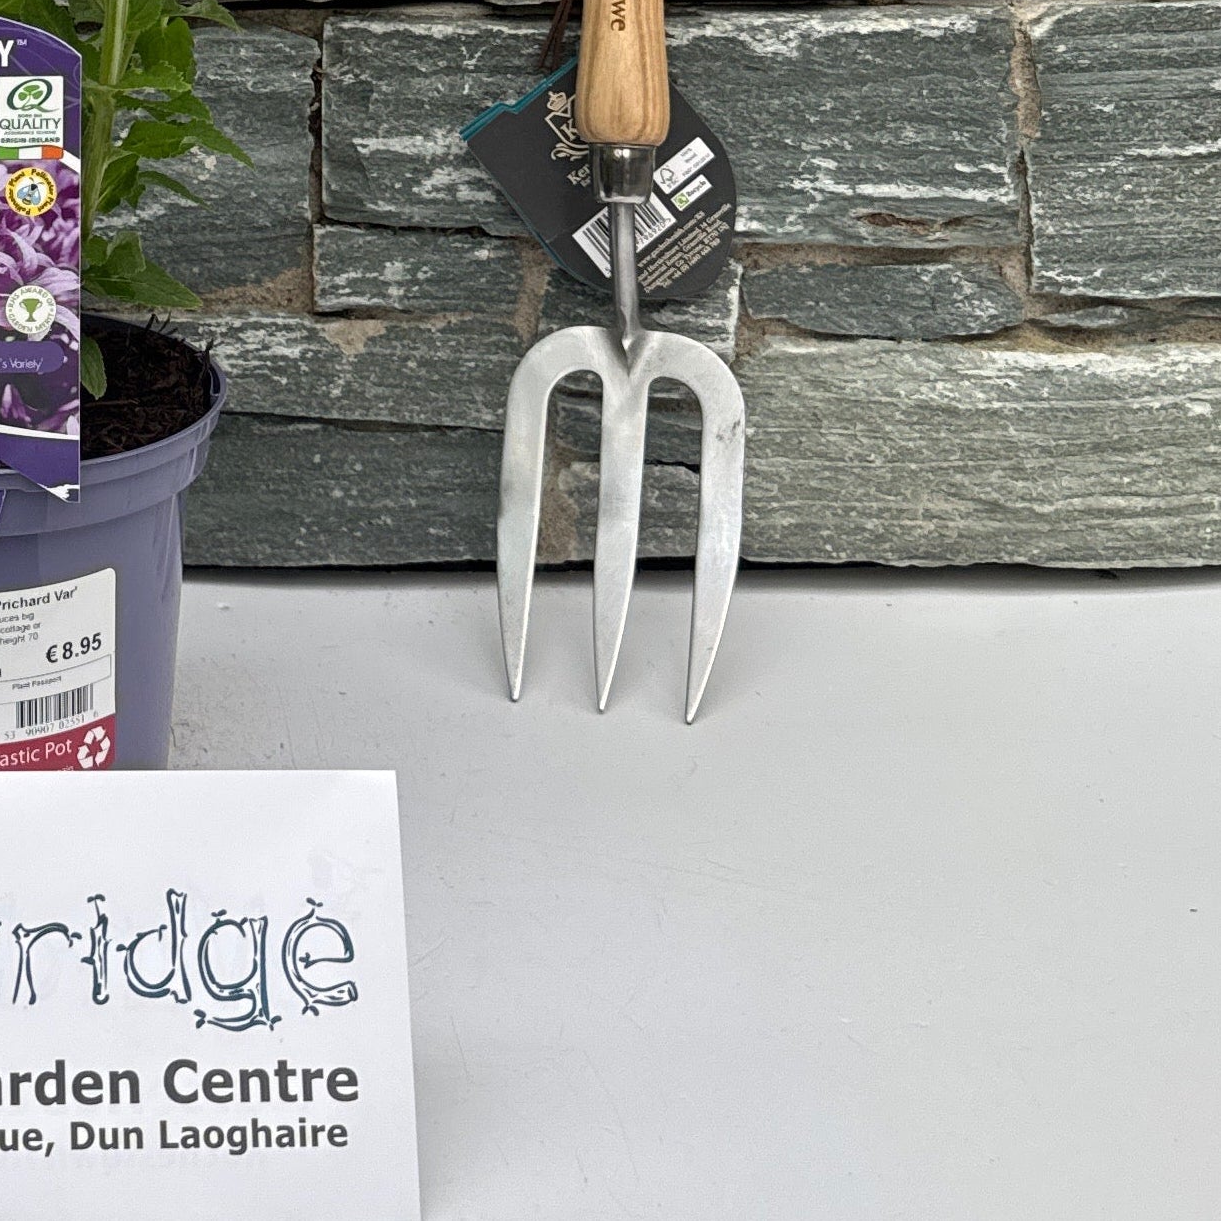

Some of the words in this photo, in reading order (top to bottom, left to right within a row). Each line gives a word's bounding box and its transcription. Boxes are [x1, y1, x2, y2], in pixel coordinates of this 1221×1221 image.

[0, 118, 61, 130] QUALITY
[21, 612, 35, 621] big
[0, 623, 31, 634] cottage
[0, 635, 26, 646] height
[28, 632, 39, 640] 70
[45, 644, 58, 664] €
[61, 632, 103, 660] 8.95
[12, 682, 31, 690] Plant
[45, 738, 73, 760] Pot
[163, 1058, 359, 1105] Centre
[69, 1120, 145, 1151] Dun
[159, 1117, 349, 1156] Laoghaire
